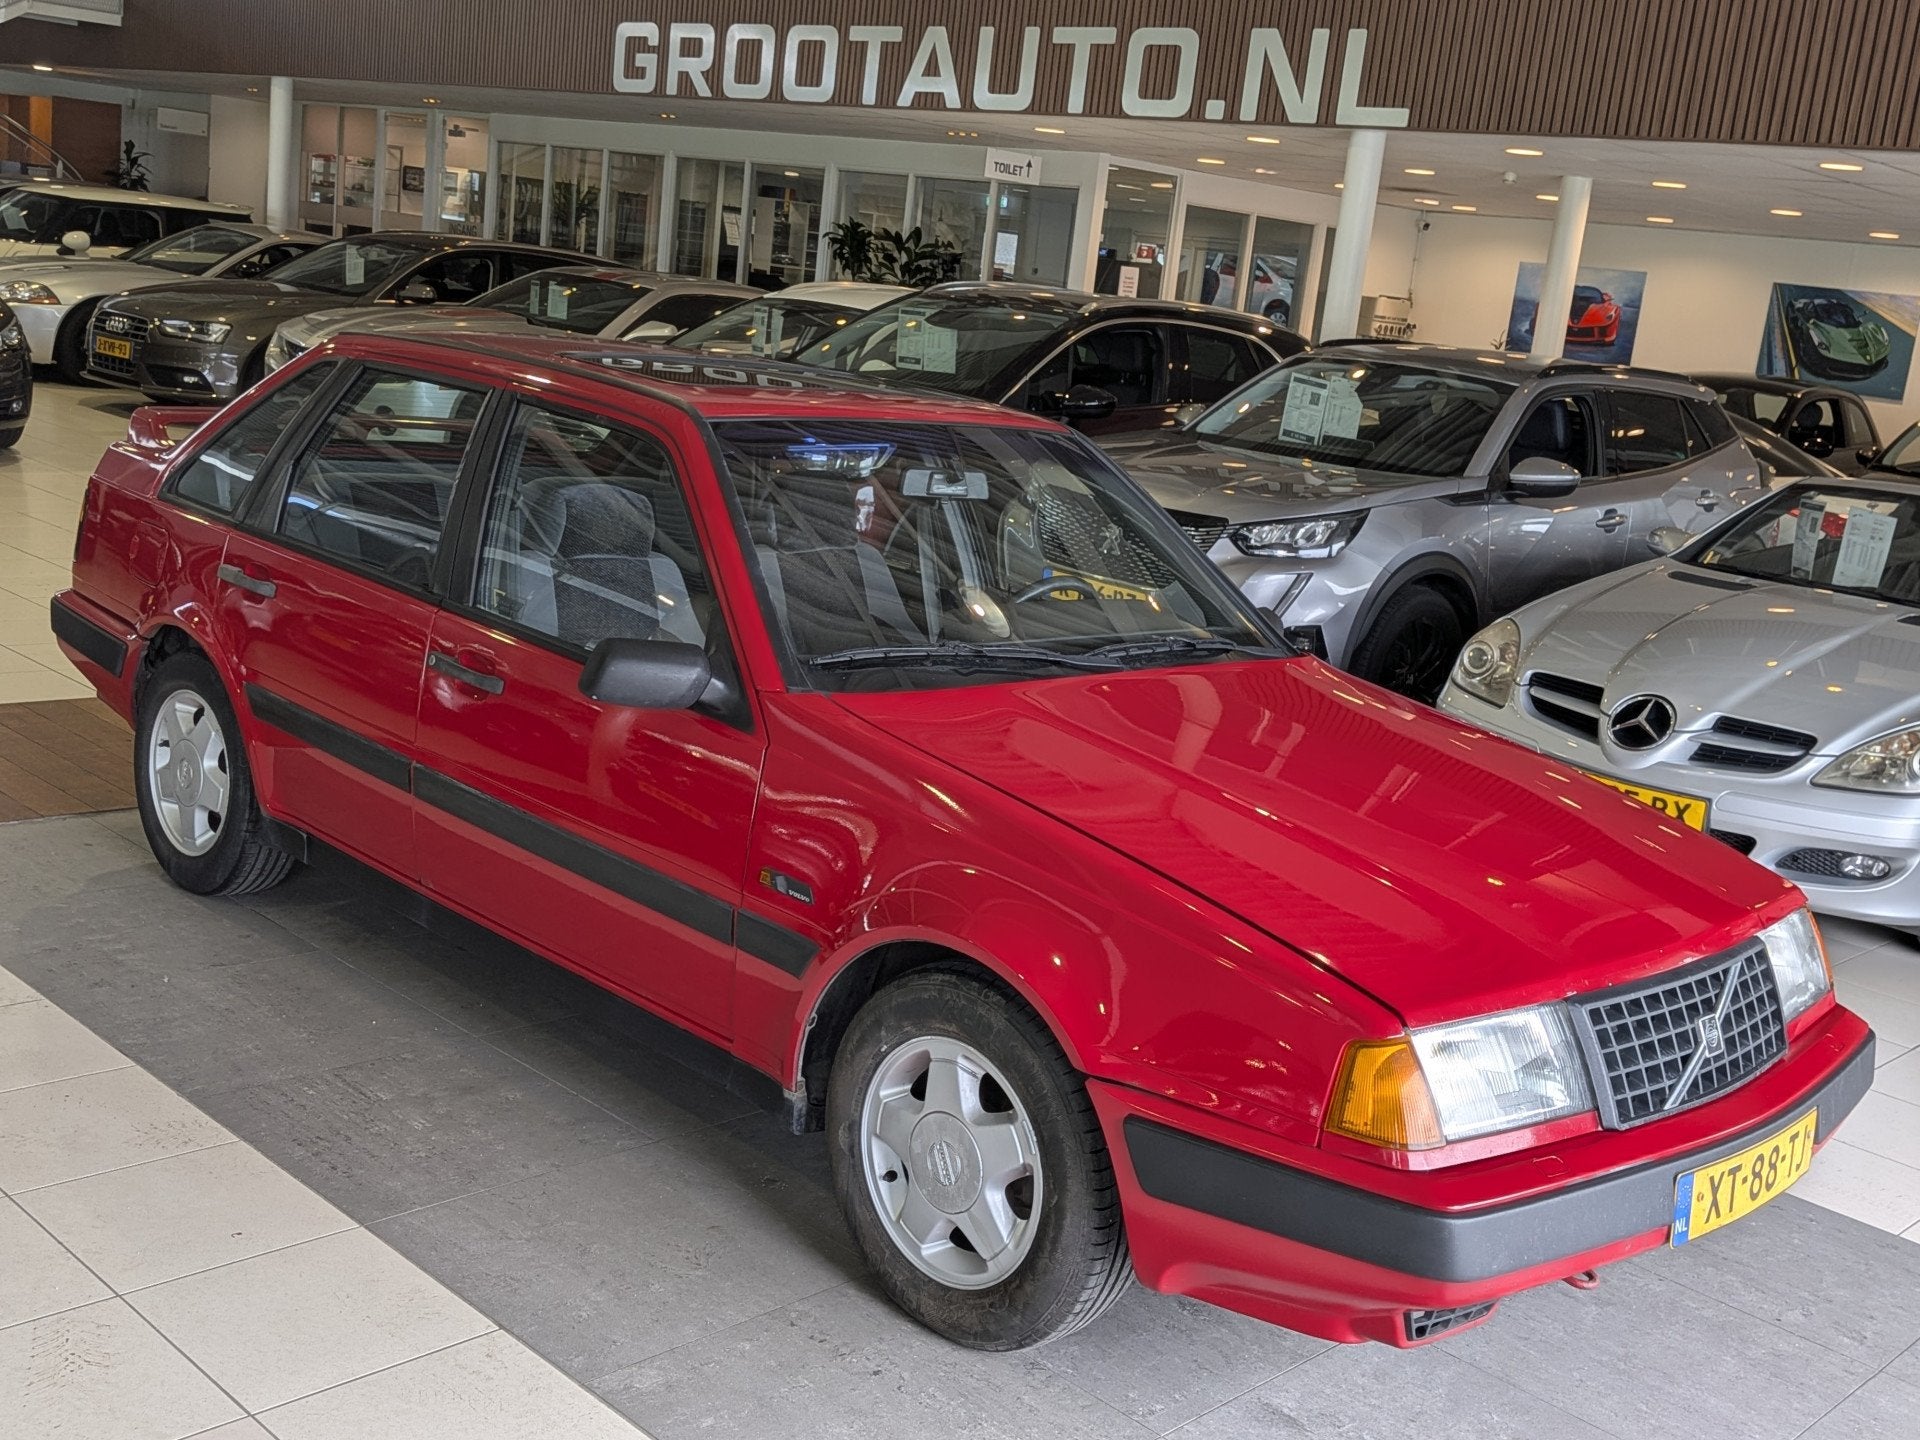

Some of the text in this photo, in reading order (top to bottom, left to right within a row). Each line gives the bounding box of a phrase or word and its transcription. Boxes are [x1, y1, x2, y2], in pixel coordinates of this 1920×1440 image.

[612, 21, 1411, 128] GROOTAUTO.NL
[993, 160, 1024, 177] TOILET
[788, 889, 810, 903] VOLVO
[1704, 1124, 1809, 1224] XT-88-TJ
[1674, 1216, 1688, 1235] NL
